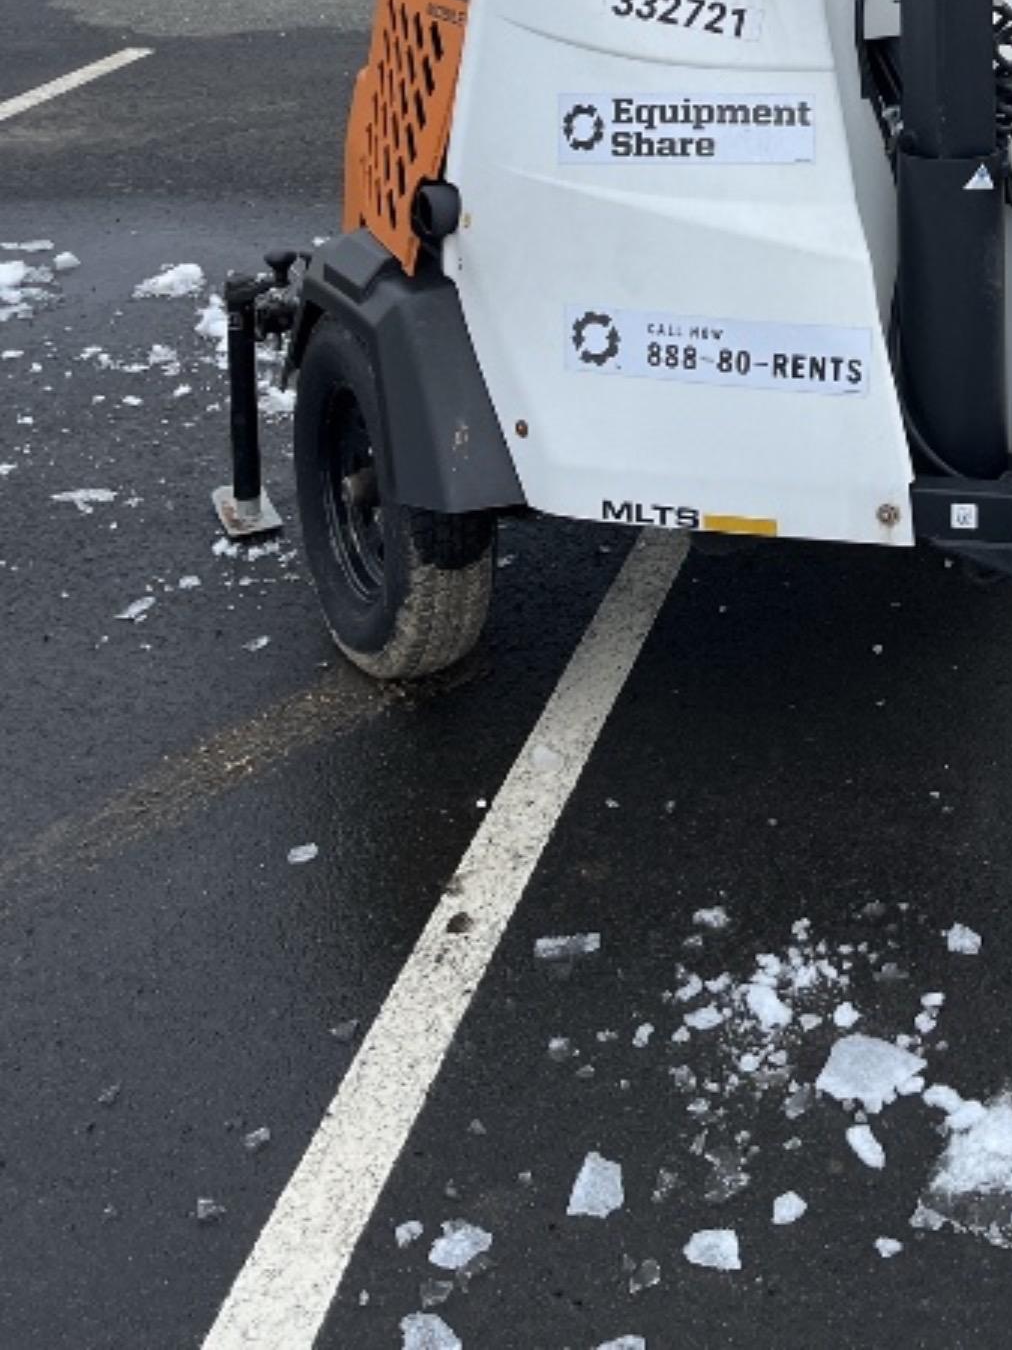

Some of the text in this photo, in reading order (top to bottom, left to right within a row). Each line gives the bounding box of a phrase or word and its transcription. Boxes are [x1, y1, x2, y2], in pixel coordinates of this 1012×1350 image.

[611, 98, 811, 130] Equipment
[611, 131, 715, 157] Share
[647, 341, 862, 384] 888-80-RENTS
